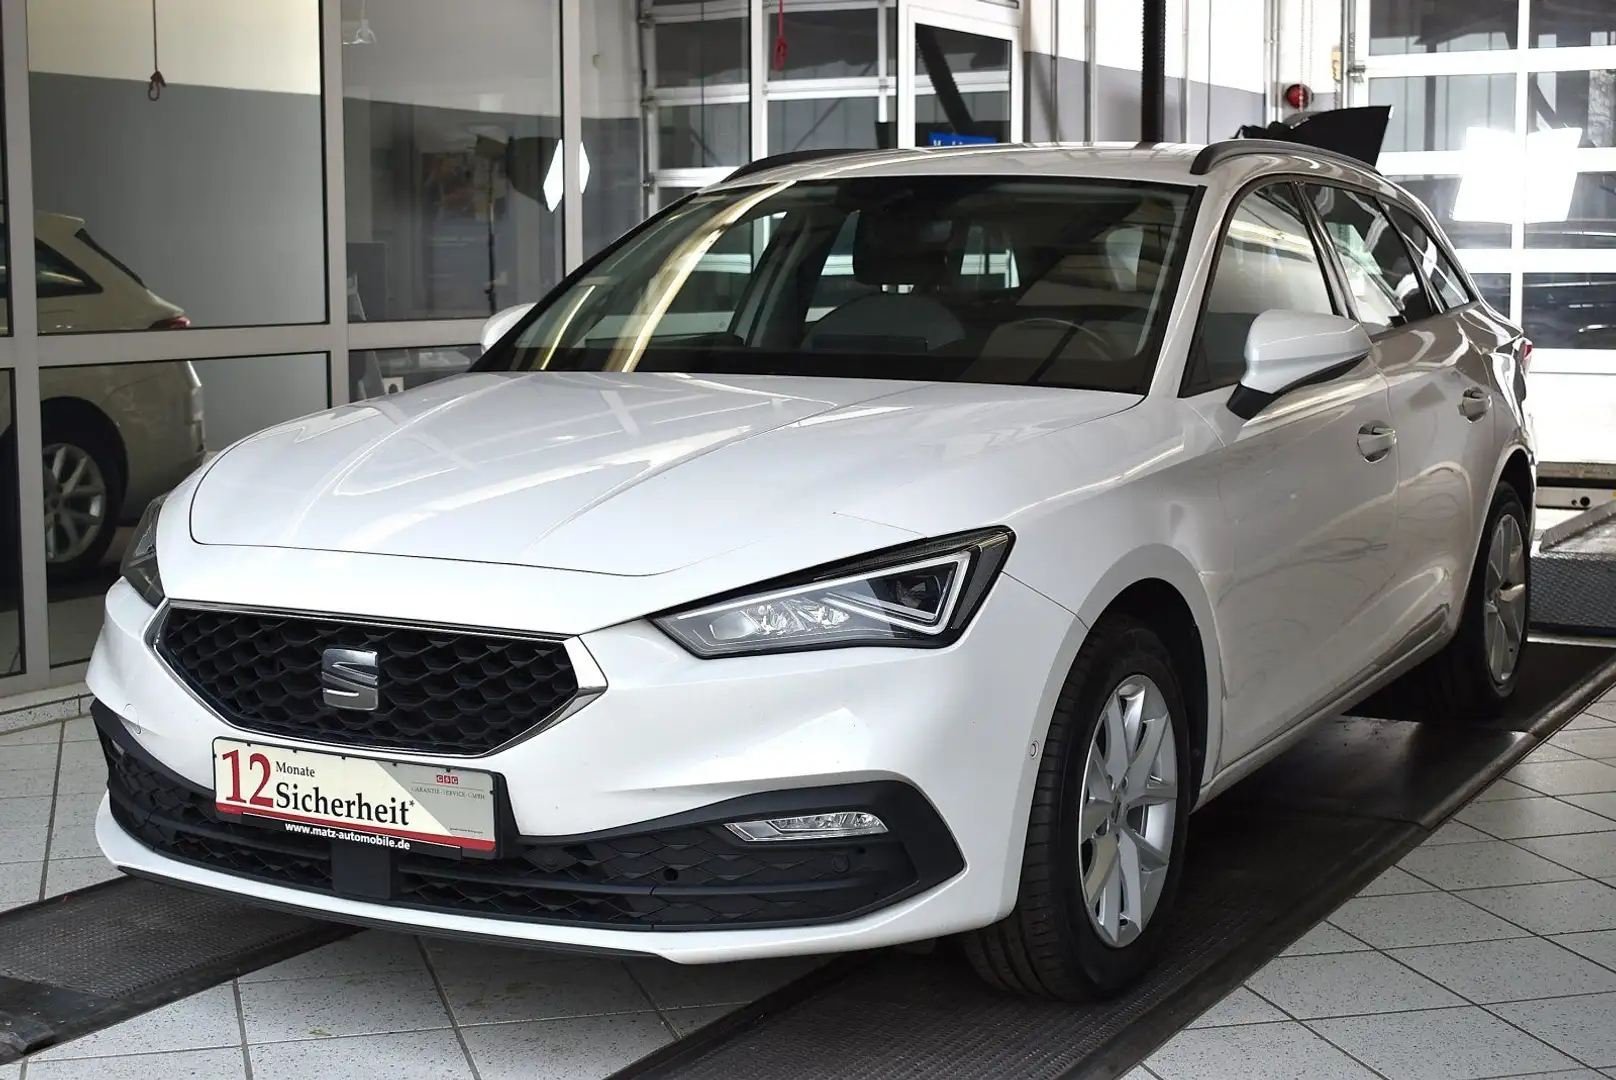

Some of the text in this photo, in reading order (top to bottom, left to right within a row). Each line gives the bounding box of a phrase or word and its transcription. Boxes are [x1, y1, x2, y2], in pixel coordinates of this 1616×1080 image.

[222, 749, 274, 808] 12
[275, 760, 316, 778] Monate
[284, 822, 411, 850] www.matz-automobile.de
